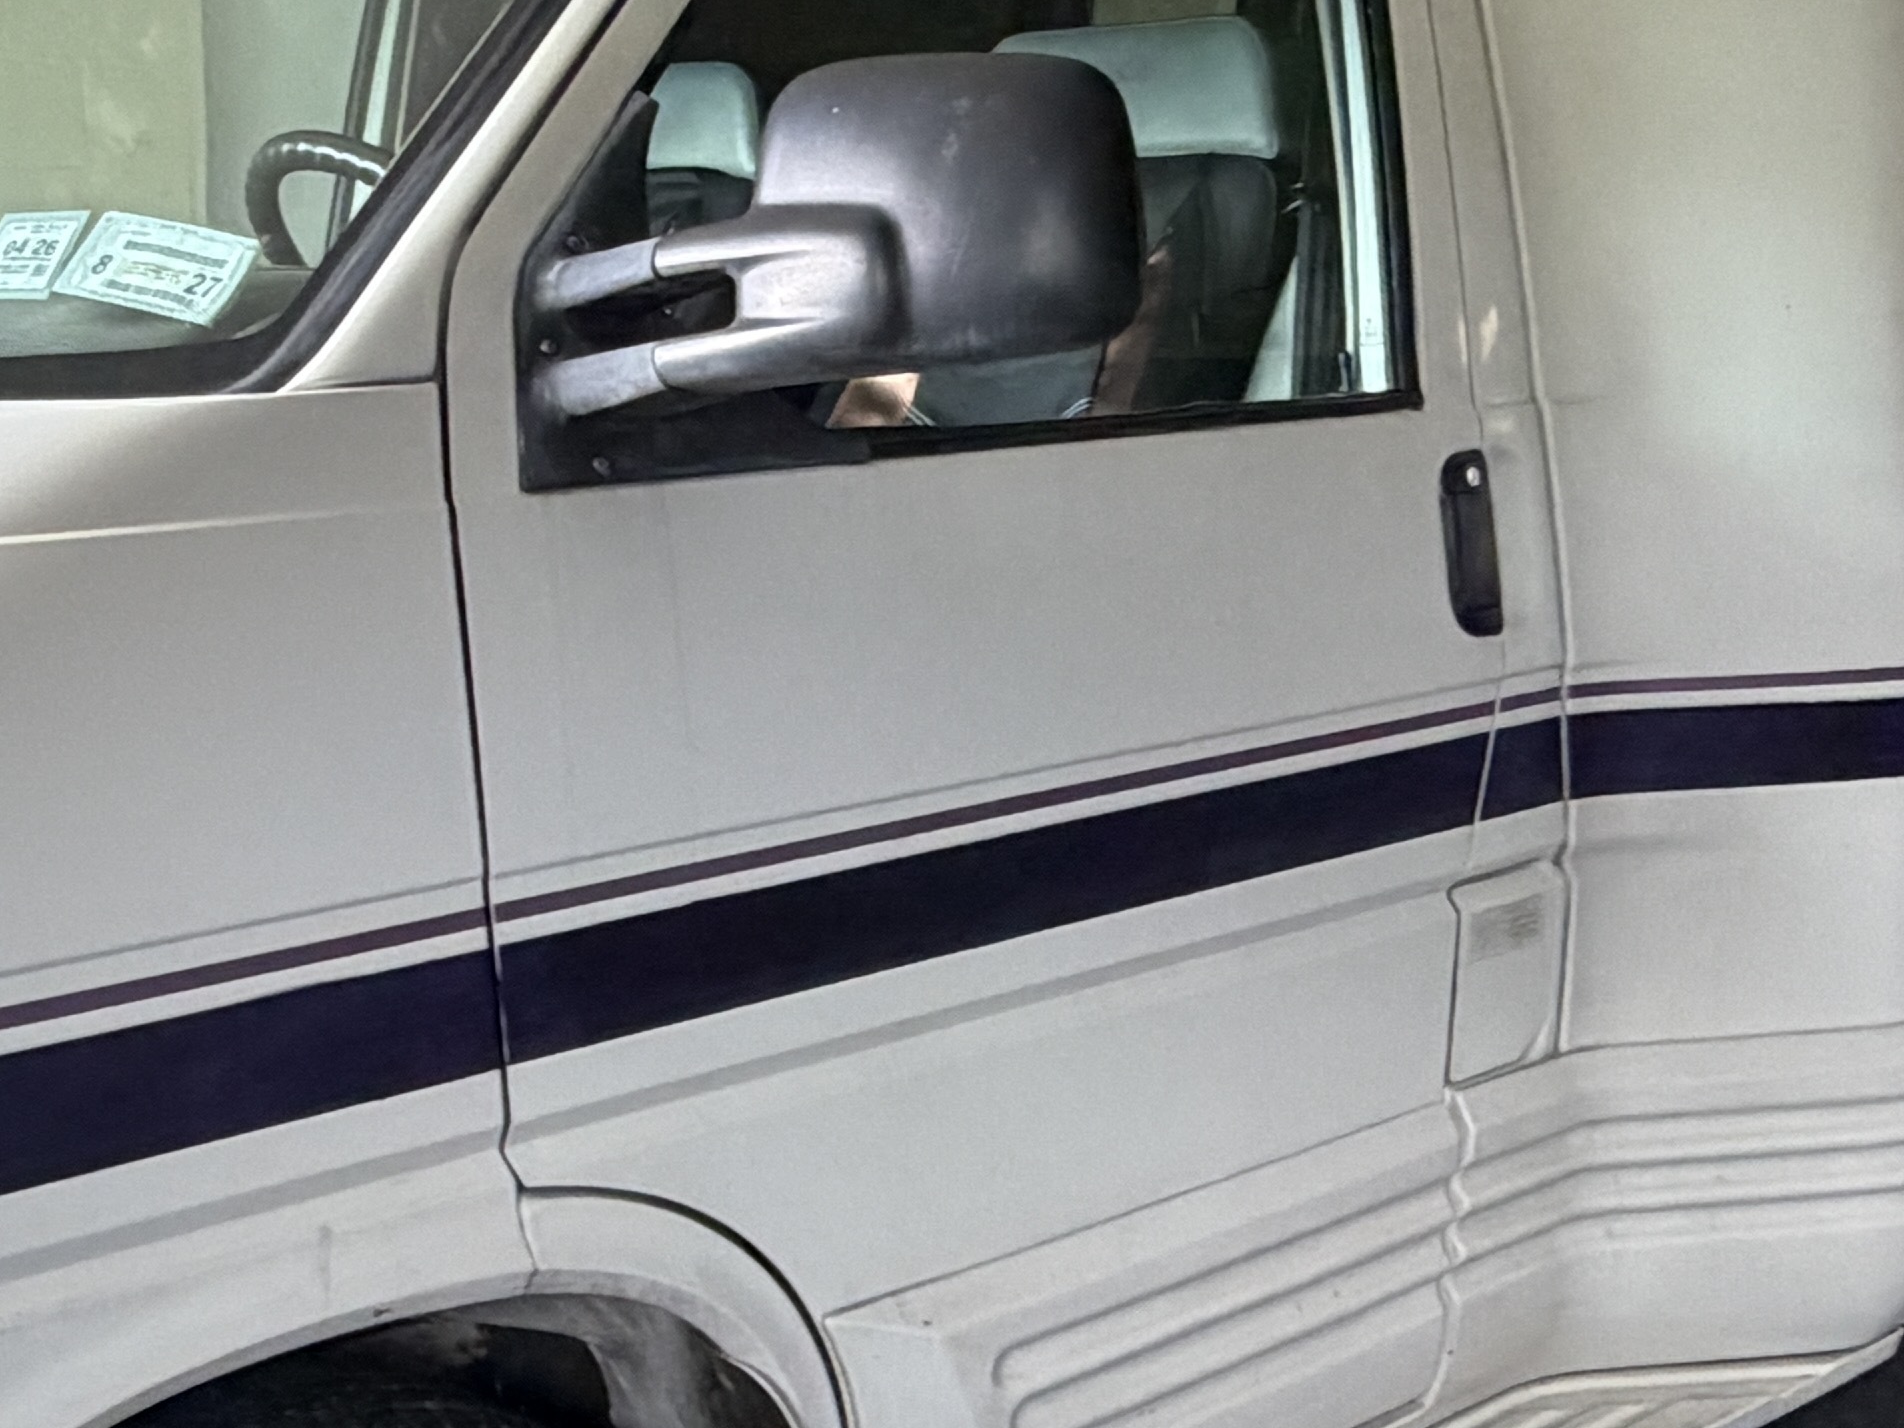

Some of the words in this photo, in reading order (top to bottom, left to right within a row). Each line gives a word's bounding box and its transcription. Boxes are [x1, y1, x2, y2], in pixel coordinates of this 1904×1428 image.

[31, 238, 60, 256] 26
[91, 254, 114, 275] 8
[183, 272, 224, 298] 27
